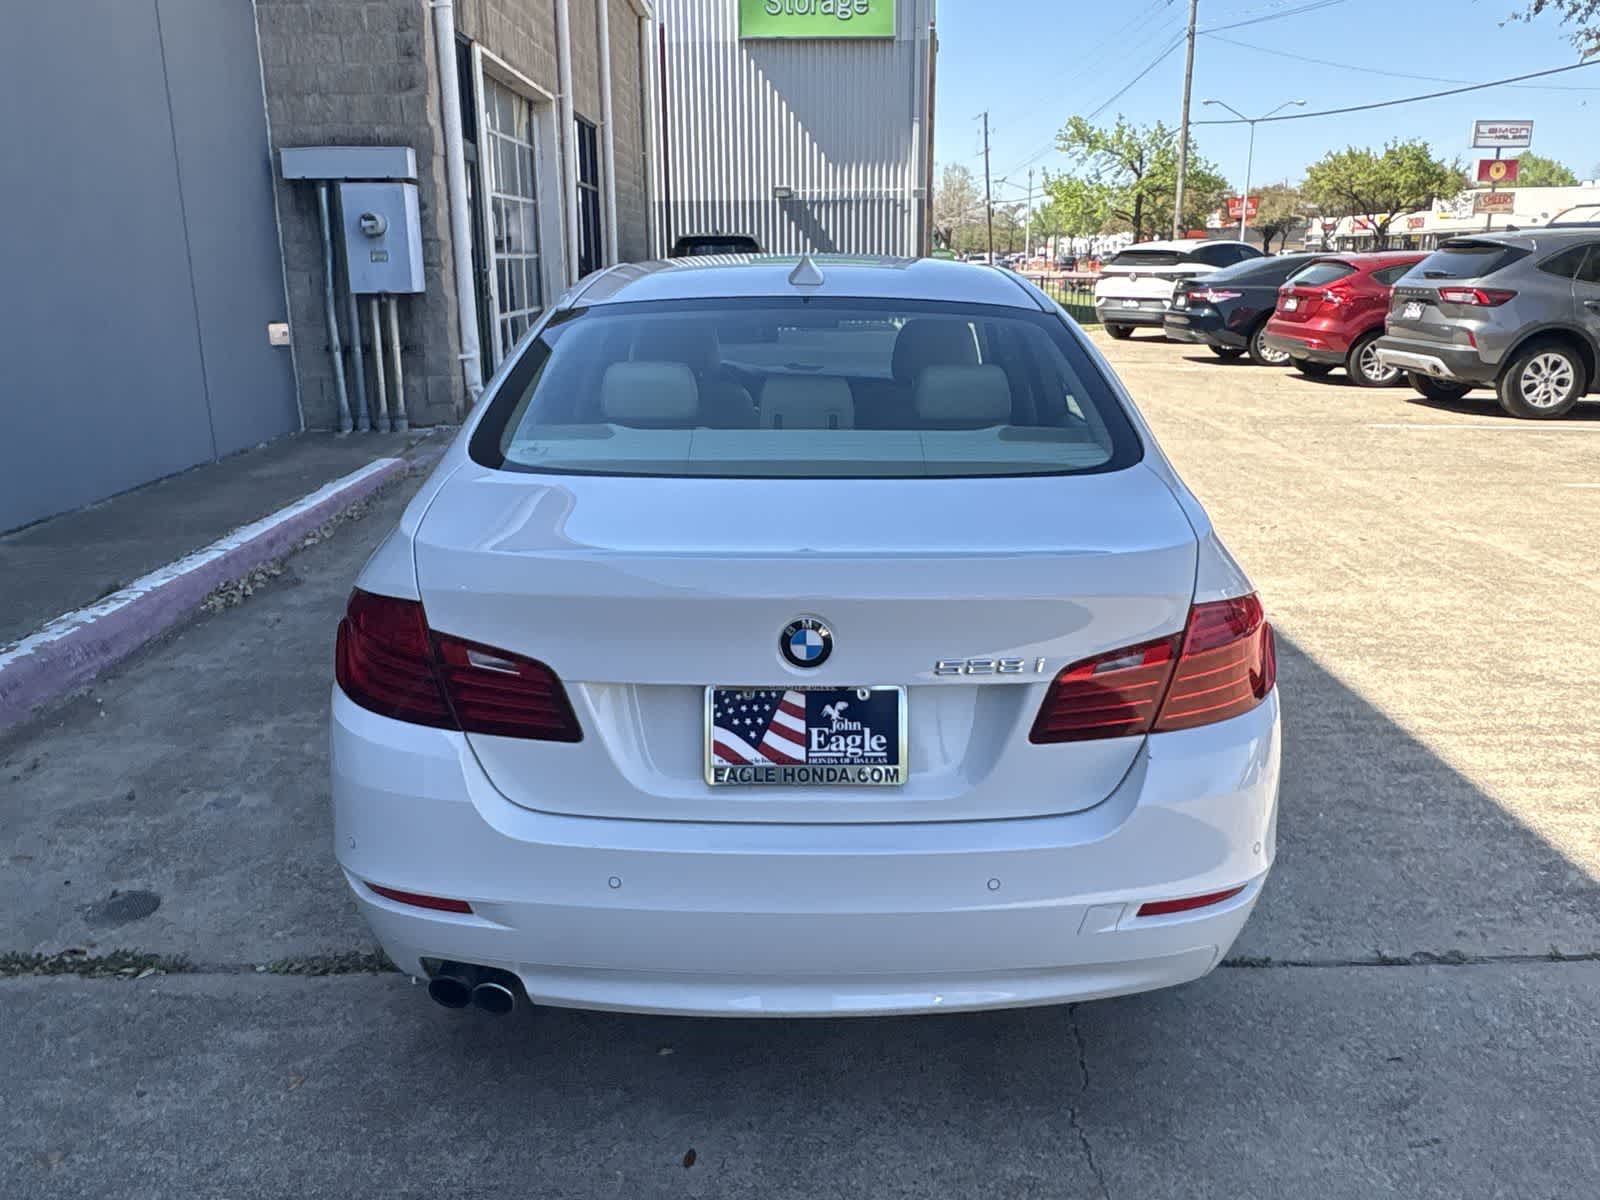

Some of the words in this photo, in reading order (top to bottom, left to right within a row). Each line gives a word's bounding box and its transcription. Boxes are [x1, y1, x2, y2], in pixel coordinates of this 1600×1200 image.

[765, 0, 869, 20] Storage
[829, 718, 862, 734] John
[808, 727, 888, 758] Eagle
[713, 767, 776, 783] EAGLE
[783, 767, 899, 783] HONDA.COM
